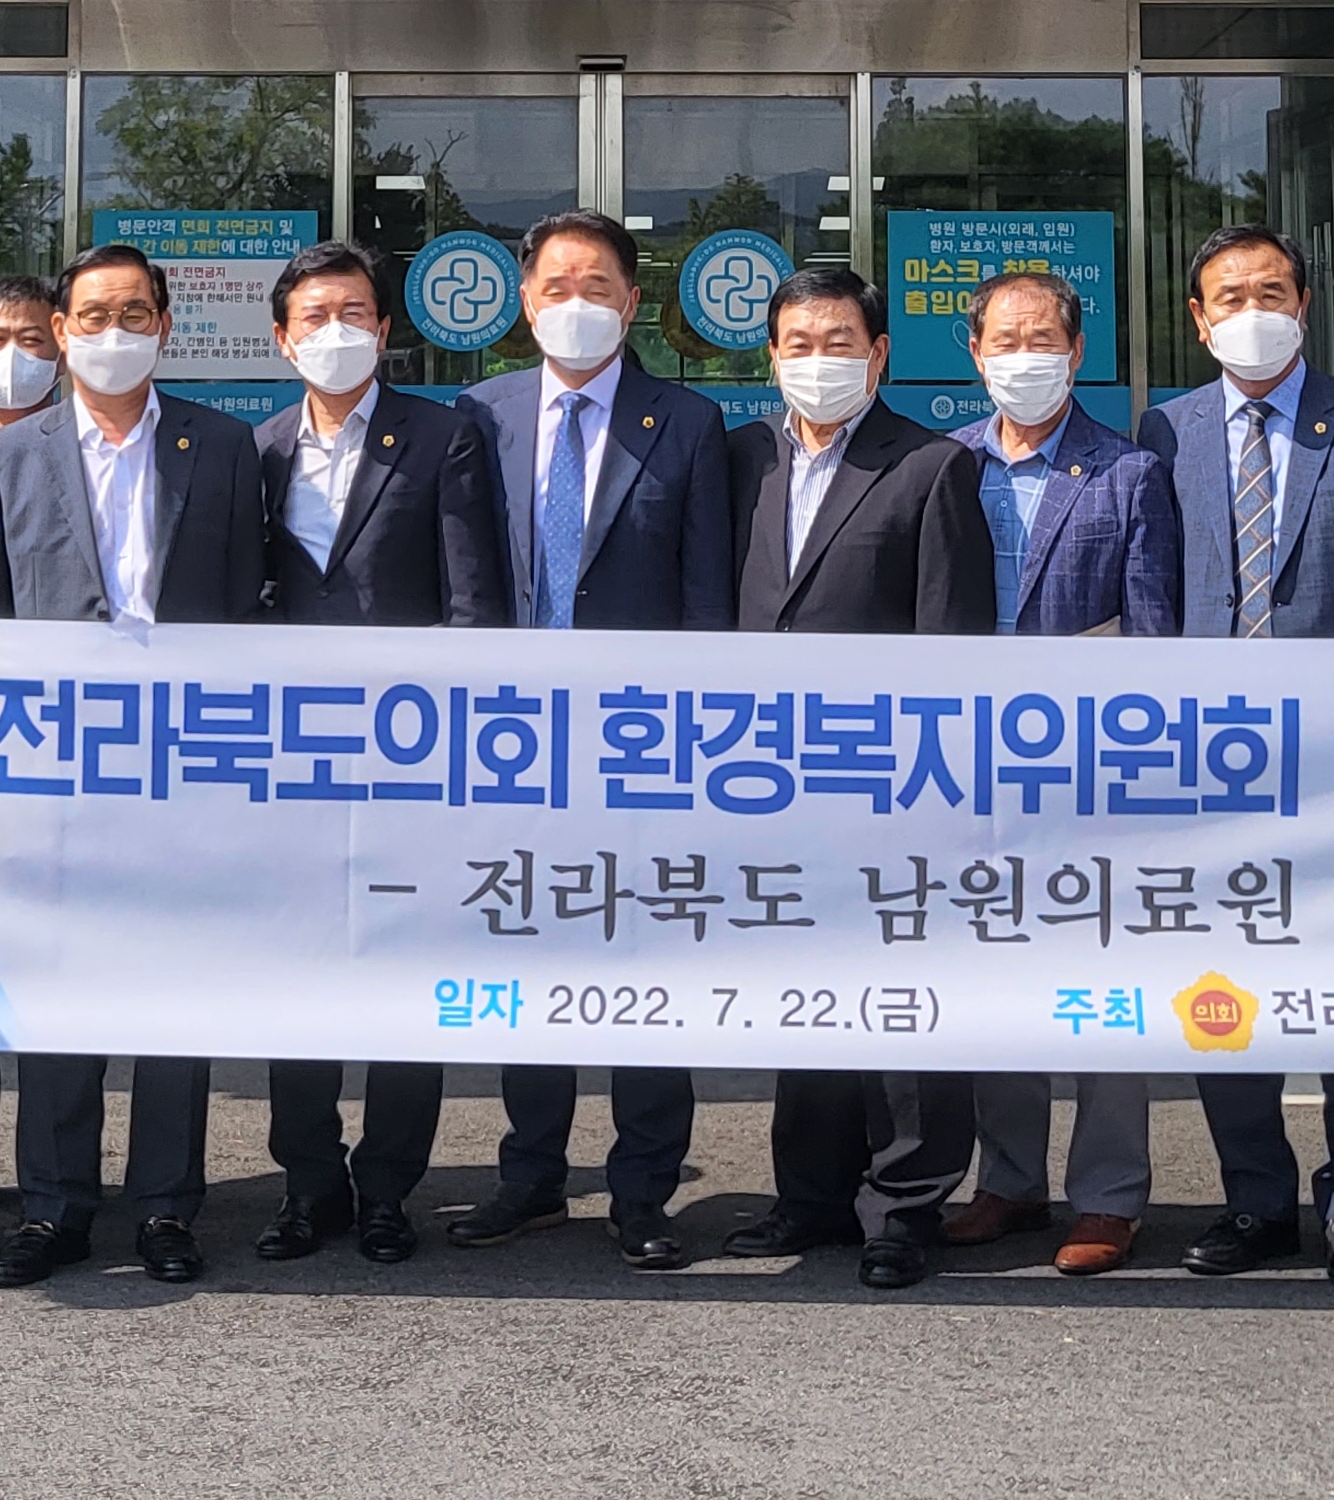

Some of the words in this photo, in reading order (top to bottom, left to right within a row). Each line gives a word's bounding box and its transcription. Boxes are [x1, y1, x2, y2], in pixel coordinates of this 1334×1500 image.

[240, 239, 268, 255] 대한
[929, 221, 956, 236] 병원
[1043, 222, 1075, 237] 입원)
[598, 685, 1301, 817] 환경복지위원회
[460, 849, 816, 943] 전라북도
[858, 855, 1300, 948] 남원의료원
[434, 978, 524, 1029] 일자
[547, 985, 684, 1028] 2022.
[712, 988, 753, 1029] 7.
[779, 987, 940, 1033] 22.(금)
[1052, 987, 1146, 1036] 주최
[1194, 1000, 1238, 1023] 의회
